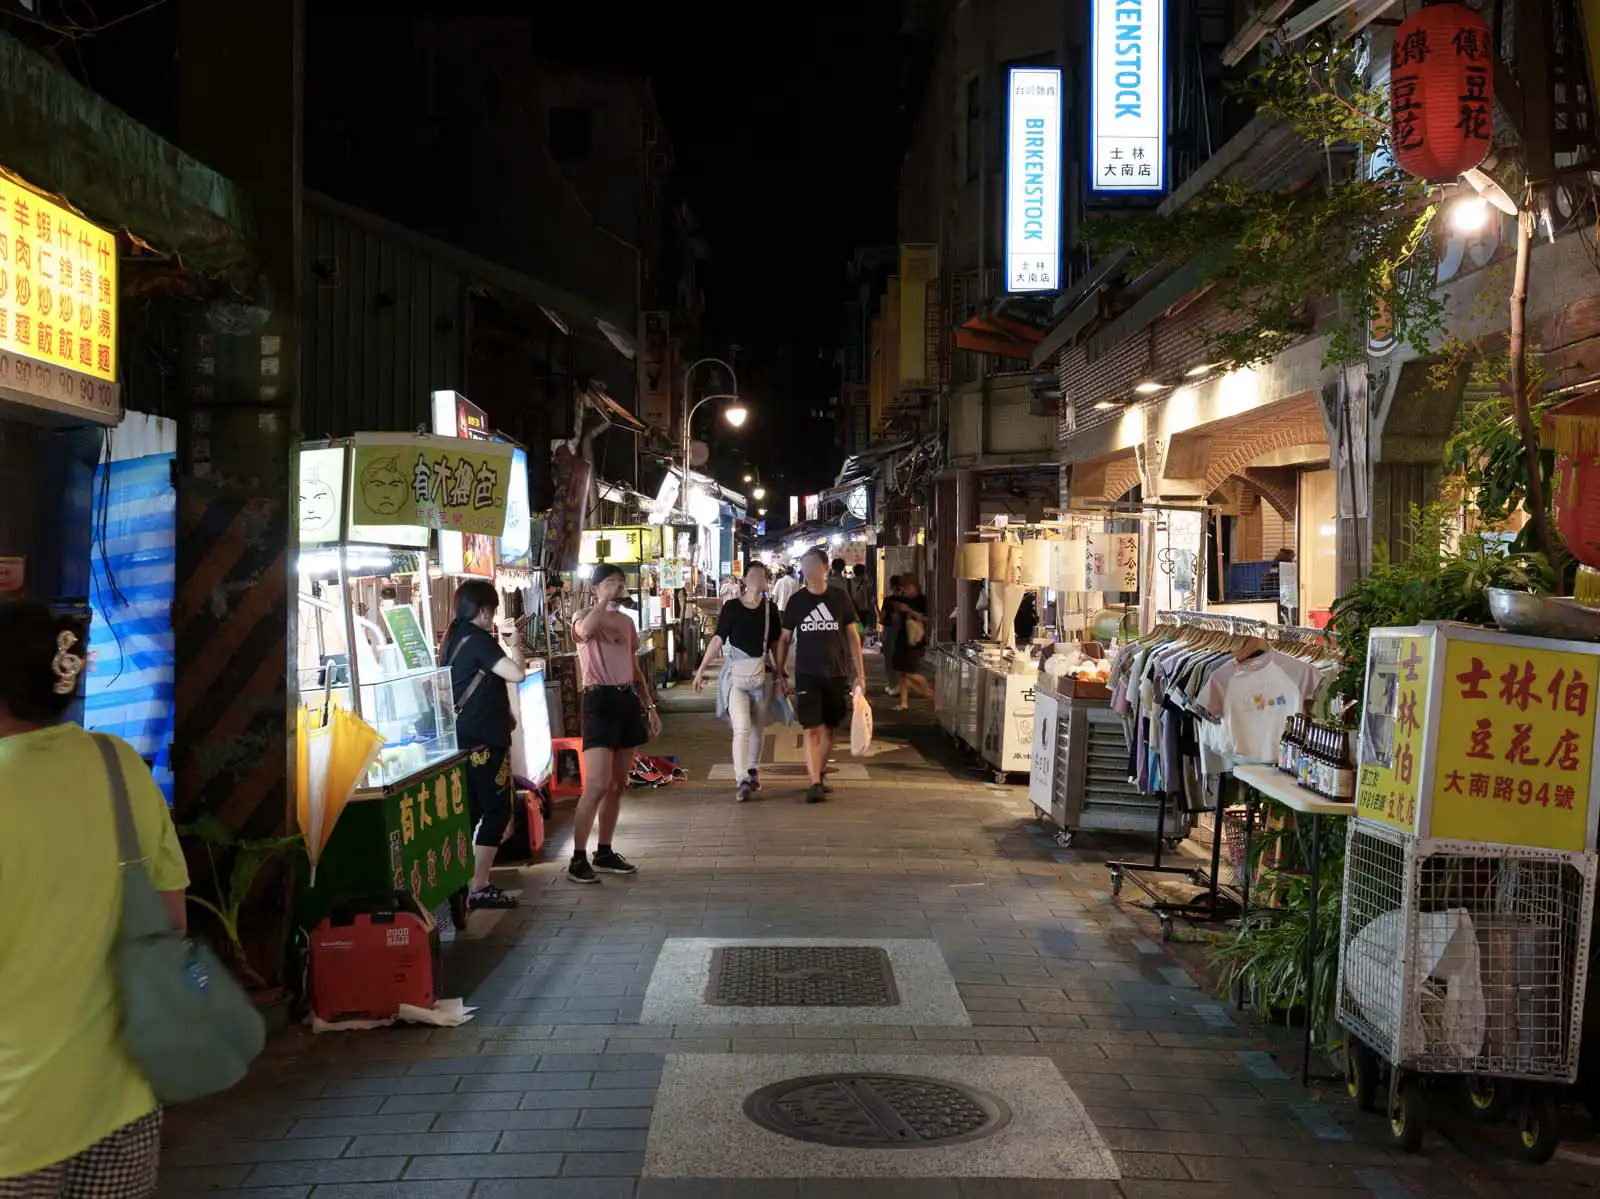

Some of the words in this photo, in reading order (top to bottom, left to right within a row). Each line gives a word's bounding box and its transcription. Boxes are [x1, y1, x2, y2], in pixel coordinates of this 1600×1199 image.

[1023, 118, 1044, 240] BIRKENSTOCK
[1104, 163, 1151, 177] 大南店
[1110, 147, 1145, 160] 士林
[14, 197, 31, 346] 羊肉炒麵
[36, 211, 53, 354] 蝦仁炒飯
[58, 219, 73, 361] 什錦炒飯
[1015, 273, 1050, 283] 大南店
[1022, 260, 1045, 271] 士林
[78, 230, 94, 367] 什錦炒麵
[97, 240, 111, 373] 什錦湯麵
[59, 372, 73, 397] 90
[80, 378, 94, 401] 90
[1124, 537, 1137, 588] 冬瓜茶
[800, 620, 839, 632] adidas
[1456, 657, 1590, 717] 士林伯
[1395, 641, 1424, 786] 士林伯
[1465, 718, 1581, 772] 豆花店
[1443, 770, 1577, 811] 大南路94號
